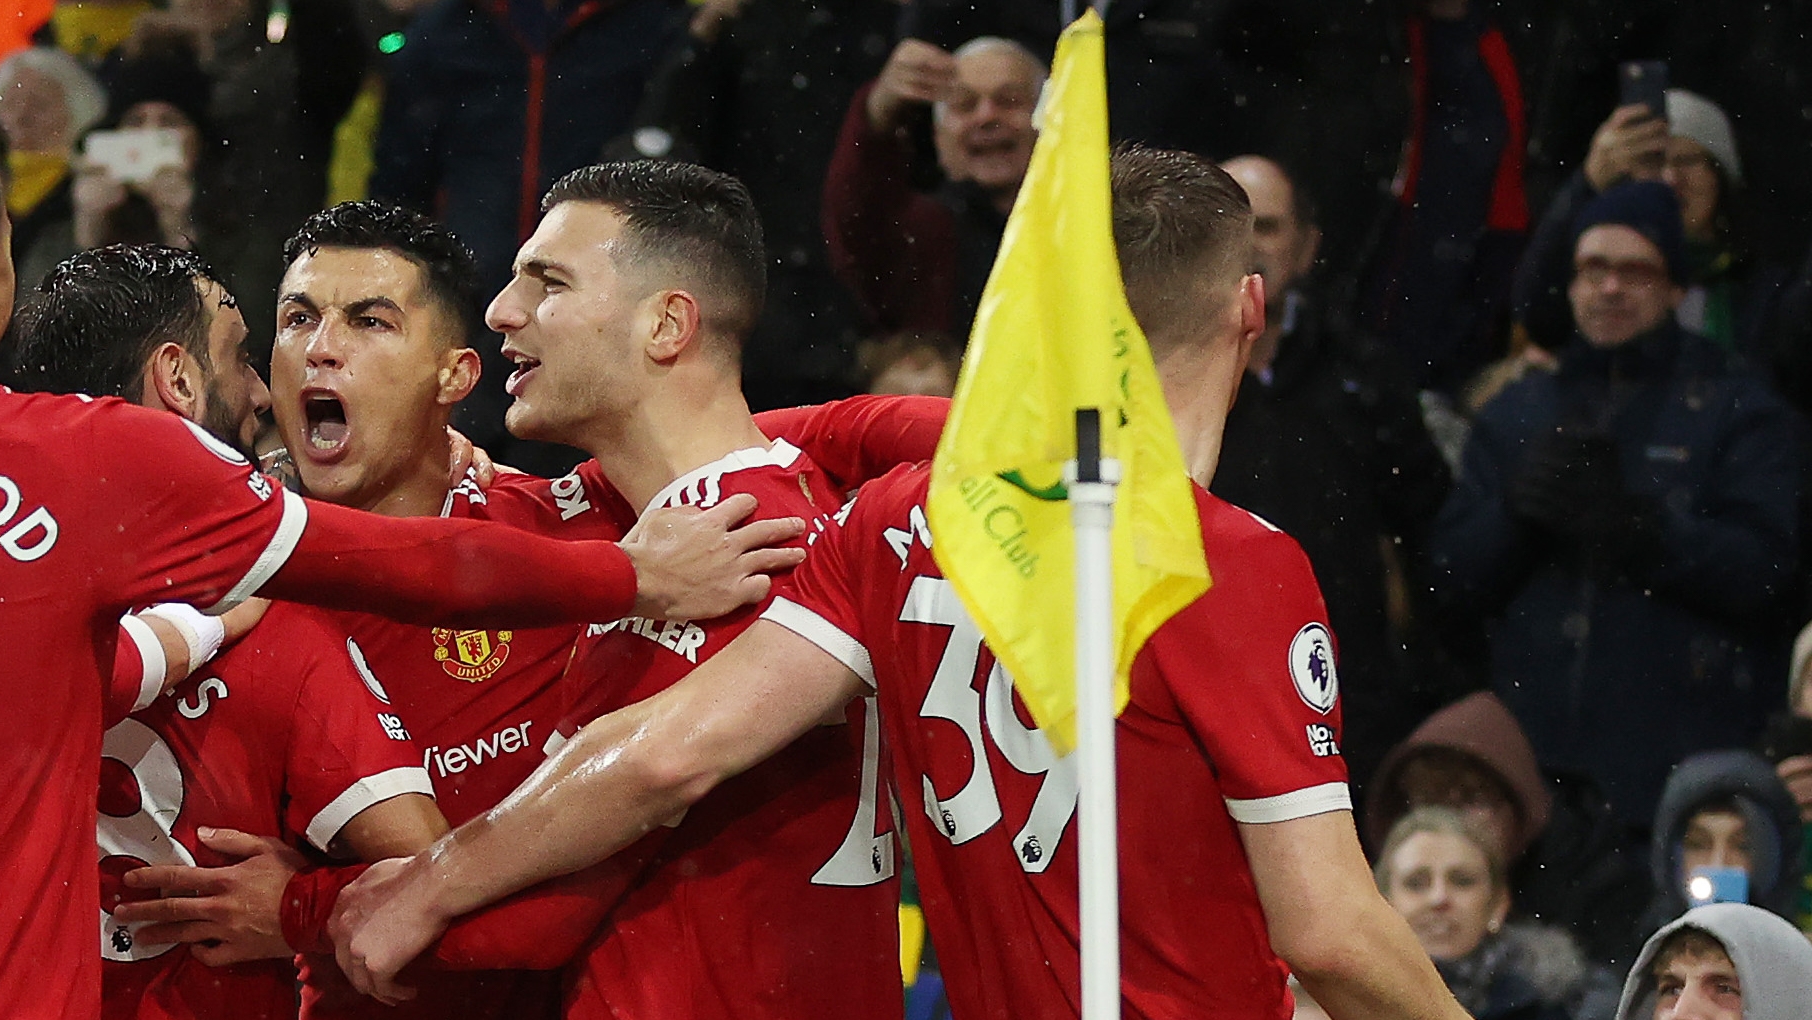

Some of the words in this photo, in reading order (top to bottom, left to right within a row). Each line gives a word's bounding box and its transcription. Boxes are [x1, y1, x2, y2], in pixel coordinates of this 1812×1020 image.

[984, 505, 1039, 579] Club
[456, 656, 502, 678] UNITED
[377, 713, 401, 729] No
[899, 575, 1080, 873] 39
[1306, 724, 1329, 742] No
